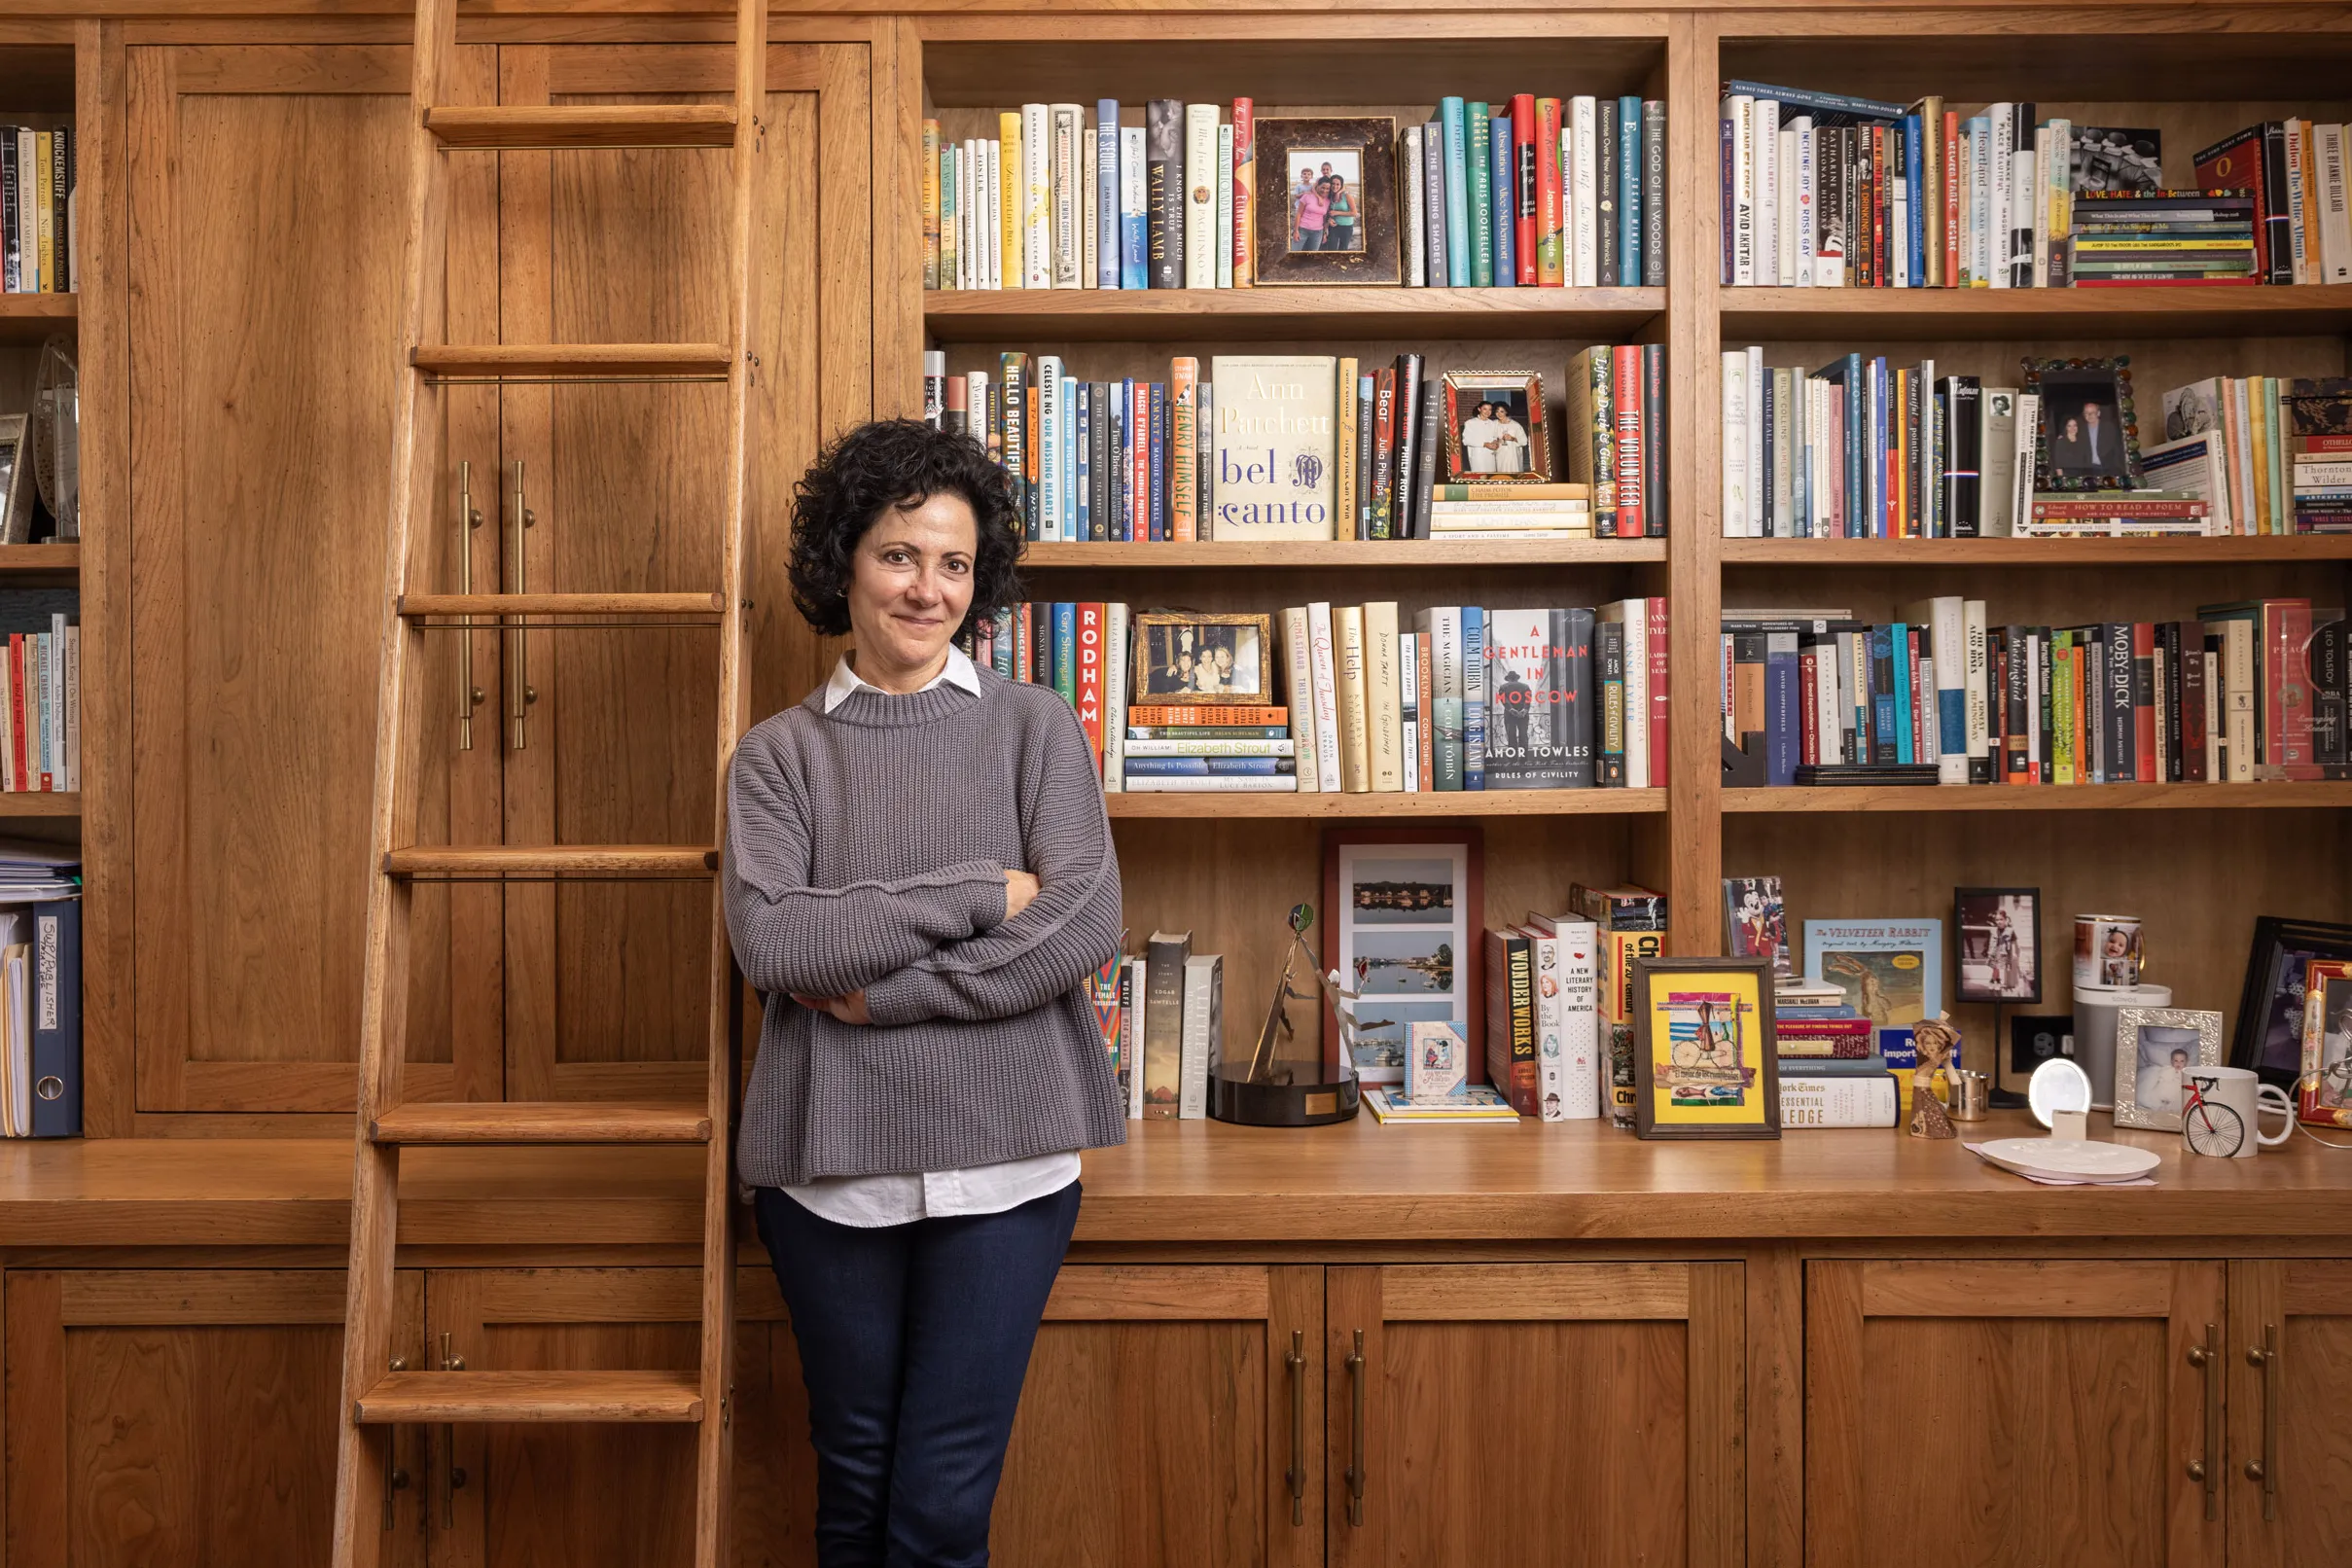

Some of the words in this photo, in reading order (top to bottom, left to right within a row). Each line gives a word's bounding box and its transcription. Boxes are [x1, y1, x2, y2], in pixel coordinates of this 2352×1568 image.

[1100, 121, 1116, 137] THE
[1652, 128, 1661, 142] THE
[1862, 126, 1871, 151] HAMILL
[1100, 141, 1116, 174] SEQUEL
[1498, 128, 1508, 176] Absolution
[1652, 146, 1661, 171] GOD
[1801, 131, 1810, 171] INCITING
[1978, 130, 1988, 187] Heartland
[2288, 132, 2299, 167] Didion
[54, 131, 65, 198] KNOCKEMSTIFF
[1152, 163, 1163, 214] WALLY
[1601, 173, 1611, 196] Jessup
[1652, 176, 1661, 189] OF
[1801, 173, 1810, 191] JOY
[2290, 169, 2301, 190] The
[1169, 193, 1175, 202] IS
[1235, 195, 1246, 224] ELINOR
[1499, 185, 1509, 208] Alice
[1547, 189, 1556, 218] James
[1652, 193, 1661, 206] THE
[2292, 191, 2302, 221] White
[1740, 204, 1751, 230] AYAD
[1861, 193, 1870, 233] DRINKING
[1152, 220, 1163, 260] LAMB
[1197, 208, 1208, 268] PACHINKO
[1235, 228, 1246, 257] LIPMAN
[1499, 209, 1509, 260] McDermott
[1548, 221, 1556, 257] McBride
[1652, 210, 1661, 255] WOODS
[1861, 235, 1870, 253] LIFE
[2294, 225, 2303, 259] Album
[1740, 233, 1751, 267] AKHTAR
[1044, 364, 1052, 399] CELESTE
[1247, 374, 1305, 401] Ann
[1044, 401, 1052, 414] NG
[1379, 389, 1392, 422] Bear
[1044, 418, 1052, 438] OUR
[1173, 405, 1194, 454] HENRY,
[1220, 407, 1331, 436] Patchett
[1619, 410, 1640, 432] THE
[1044, 441, 1052, 479] MISSING
[1377, 437, 1387, 460] Julia
[1401, 445, 1409, 477] PHILIP
[1220, 447, 1277, 484] bel
[1375, 462, 1387, 496] Phillips
[1619, 438, 1640, 507] VOLUNTEER
[2302, 465, 2352, 475] Thornton
[2311, 475, 2346, 484] Wilder
[1044, 482, 1052, 517] HEARTS
[1175, 455, 1194, 517] HIMSELF
[1399, 478, 1409, 503] ROTH
[1218, 500, 1326, 527] canto
[1059, 611, 1071, 634] Gary
[1530, 624, 1540, 638] A
[1969, 624, 1978, 648] ALSO
[1467, 626, 1480, 656] COLM
[1482, 644, 1587, 660] GENTLEMAN
[2325, 630, 2334, 646] LEO
[1058, 636, 1071, 687] Shteyngart
[1082, 611, 1097, 722] RODHAM
[1343, 646, 1361, 681] Help
[1443, 642, 1452, 694] MAGICIAN
[1969, 650, 1978, 675] RISES
[2041, 641, 2050, 666] Bernard
[2113, 625, 2129, 710] MOBY-DICK
[2325, 646, 2334, 685] TOLSTOY
[1420, 646, 1430, 698] BROOKLYN
[1467, 658, 1482, 692] TÓIBÍN
[1527, 667, 1545, 681] IN
[2010, 637, 2022, 702] Mockingbird
[2041, 667, 2050, 695] Malamud
[1495, 691, 1578, 704] MOSCOW
[1807, 683, 1817, 697] Great
[1469, 706, 1481, 732] LONG
[1807, 697, 1817, 731] Expectations
[1177, 742, 1231, 754] Elizabeth
[1233, 742, 1270, 754] Strout
[1469, 734, 1481, 768] ISLAND
[1486, 745, 1526, 759] AMOR
[1527, 745, 1589, 759] TOWLES
[1815, 928, 1827, 938] The
[1829, 928, 1885, 938] VELVETEEN
[1888, 927, 1932, 938] RABBIT
[1134, 967, 1143, 994] Another
[1196, 980, 1208, 992] A
[1132, 995, 1143, 1026] Brooklyn
[1183, 990, 1194, 1020] HANYA
[1510, 949, 1533, 1054] WONDERWORKS
[1541, 1005, 1550, 1014] By
[2111, 995, 2137, 1004] SONOS
[1194, 996, 1208, 1051] LITTLE
[1183, 1023, 1194, 1080] YANAGIHARA
[1194, 1054, 1208, 1090] LIFE
[1617, 1090, 1636, 1103] Chr
[1798, 1083, 1825, 1091] Times
[1781, 1109, 1823, 1123] LEDGE
